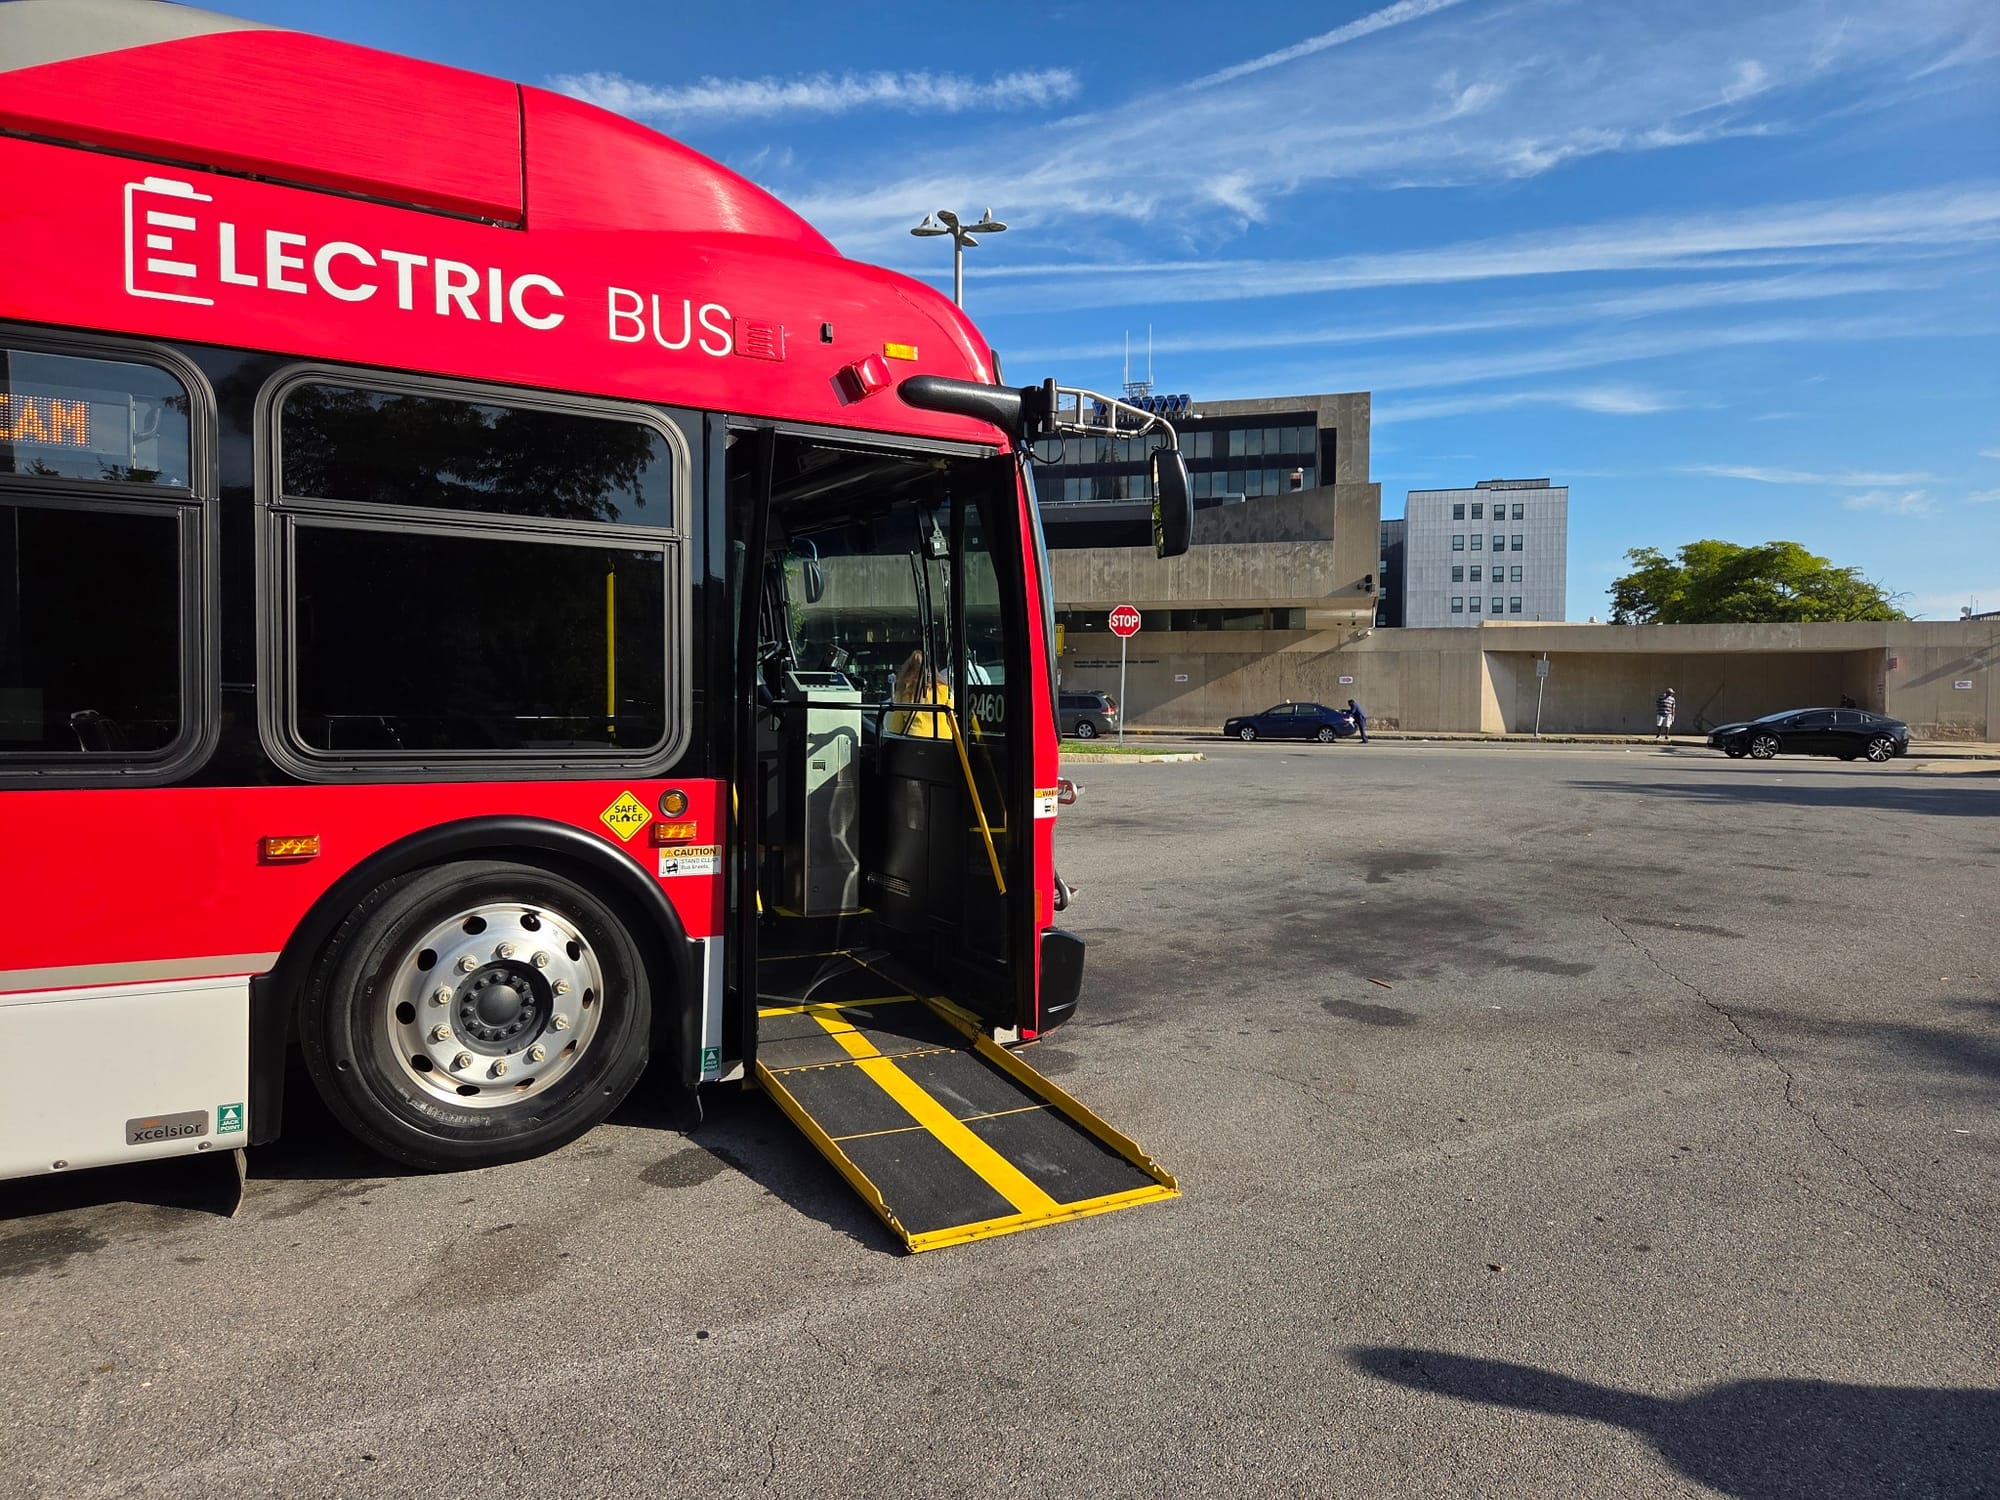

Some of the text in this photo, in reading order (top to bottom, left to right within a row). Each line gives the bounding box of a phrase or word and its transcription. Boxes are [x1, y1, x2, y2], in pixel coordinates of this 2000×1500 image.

[123, 176, 733, 357] ELECTRIC BUS
[1112, 615, 1139, 628] STOP
[968, 693, 1005, 723] 2460
[614, 804, 637, 813] SAFE
[673, 847, 717, 857] CAUTION
[134, 1124, 202, 1142] xcelsior
[220, 1124, 241, 1132] POINT
